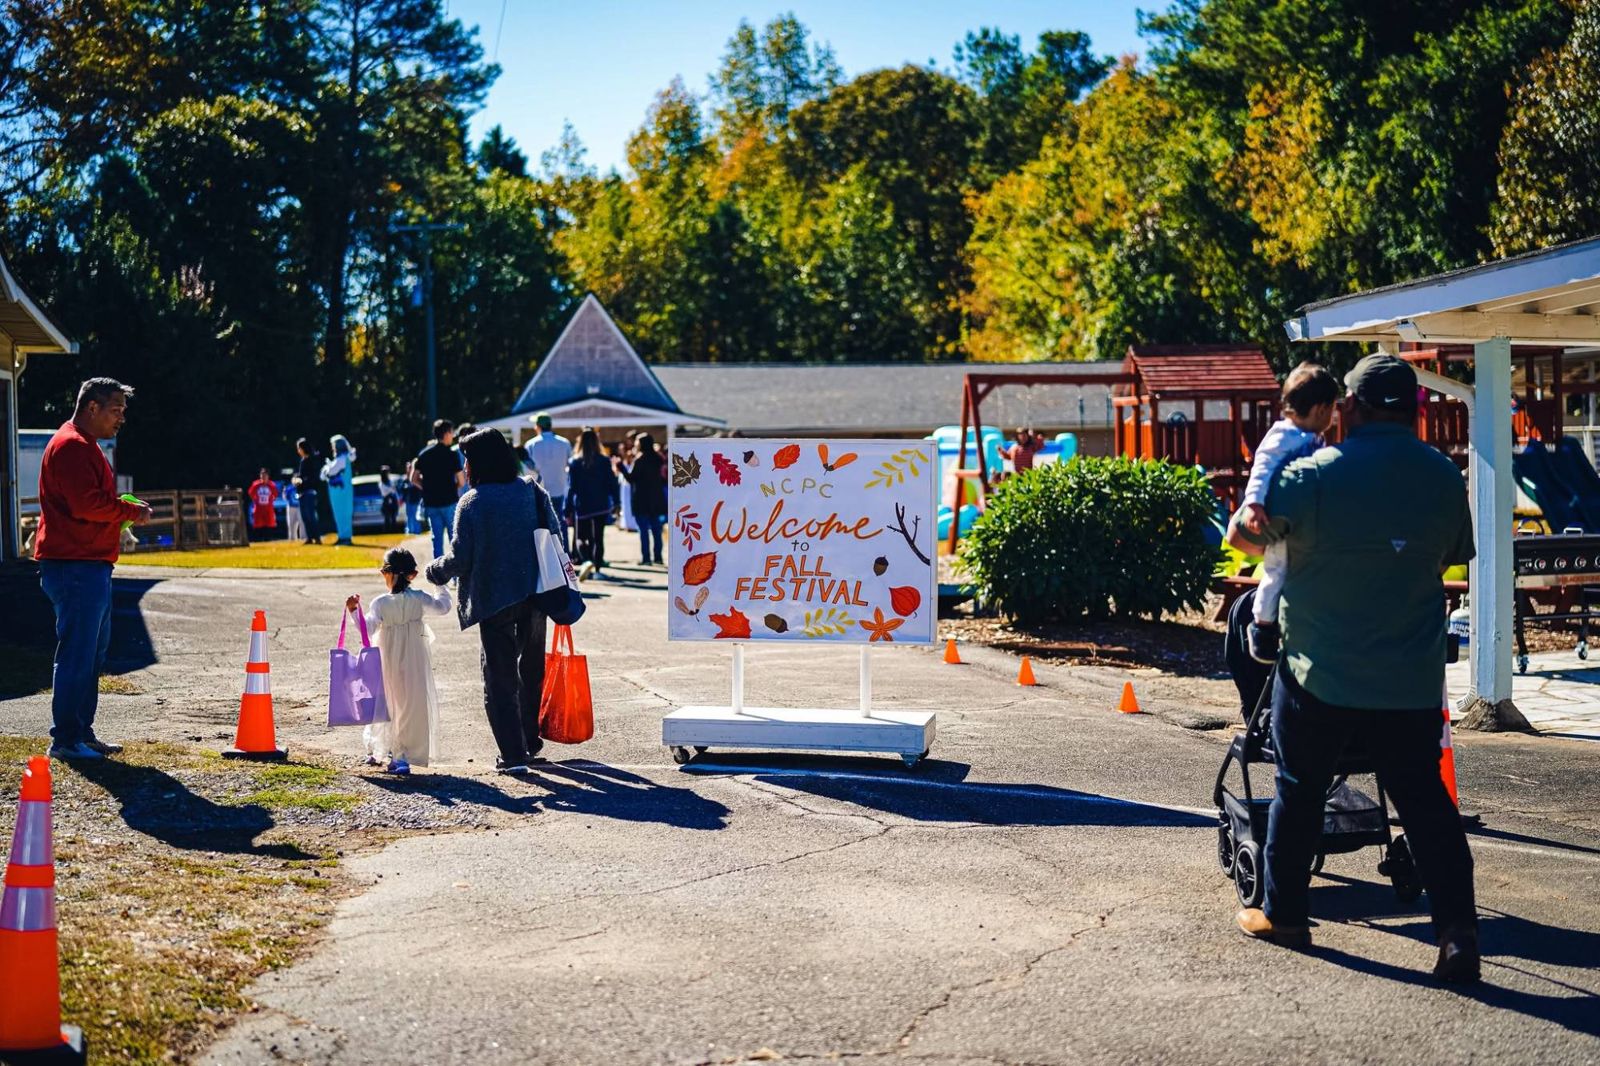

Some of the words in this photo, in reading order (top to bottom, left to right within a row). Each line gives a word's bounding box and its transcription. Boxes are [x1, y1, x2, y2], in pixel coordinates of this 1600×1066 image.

[711, 499, 883, 543] Welcome
[791, 540, 809, 552] to
[764, 555, 832, 577] FALL
[735, 577, 868, 606] FESTIVAL
